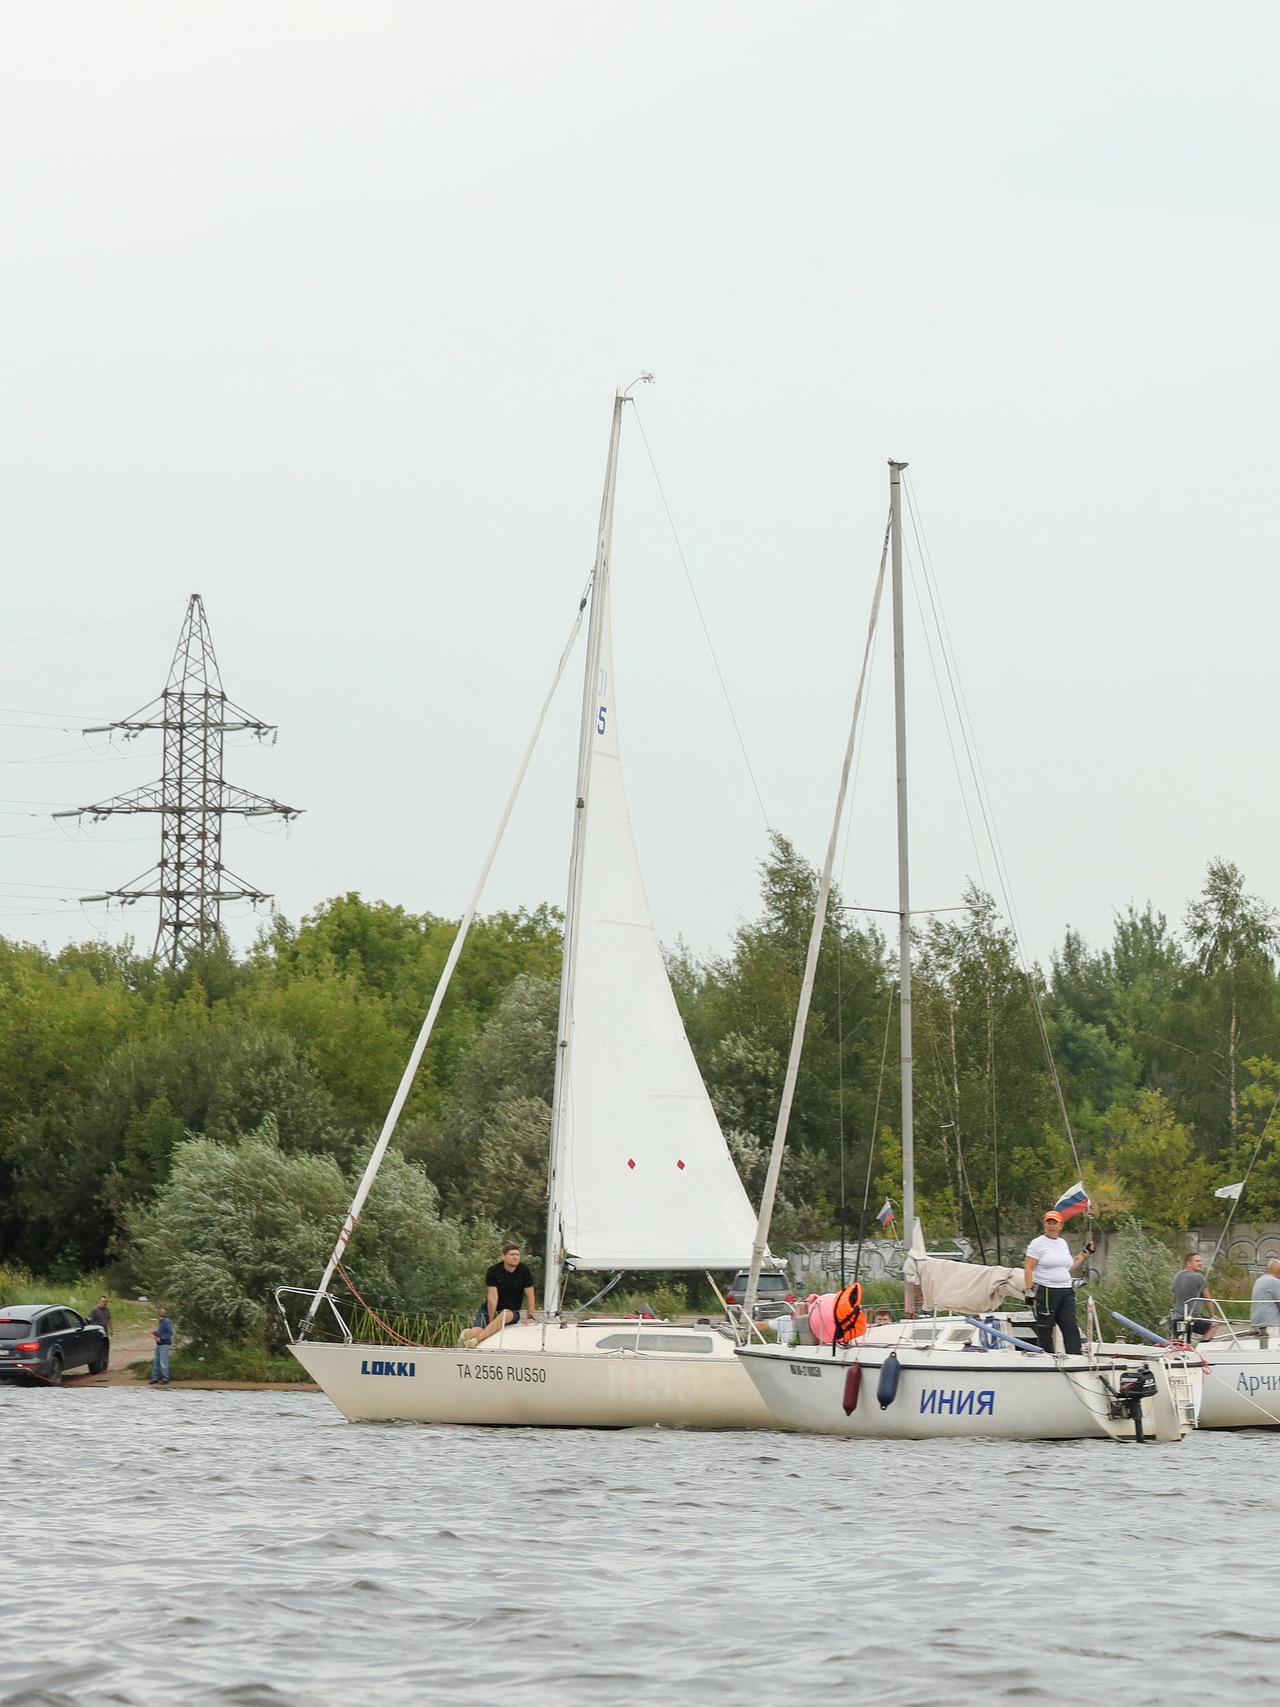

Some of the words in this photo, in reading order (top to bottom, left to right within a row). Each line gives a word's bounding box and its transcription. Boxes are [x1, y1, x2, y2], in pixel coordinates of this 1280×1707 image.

[361, 1360, 416, 1377] LOKKI
[457, 1364, 472, 1379] TA
[475, 1365, 503, 1380] 2556
[507, 1367, 546, 1383] RUS50
[920, 1389, 995, 1415] ИНИЯ
